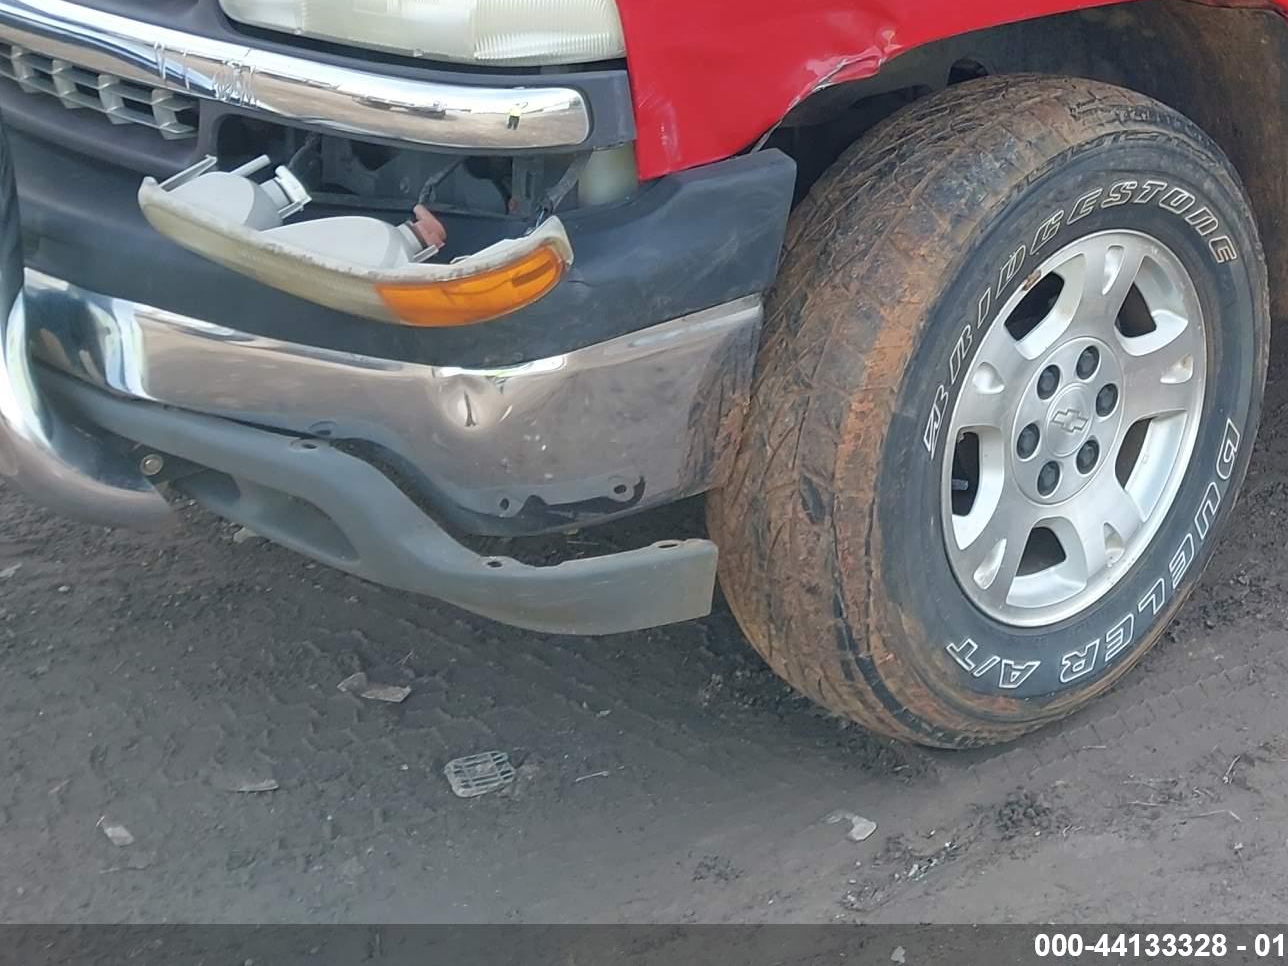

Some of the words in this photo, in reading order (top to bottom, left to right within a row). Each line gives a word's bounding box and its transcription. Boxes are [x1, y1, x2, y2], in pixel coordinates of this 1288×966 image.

[923, 180, 1238, 460] BRIDGESTONE
[946, 638, 1041, 689] A/T
[1059, 418, 1240, 683] DUELER
